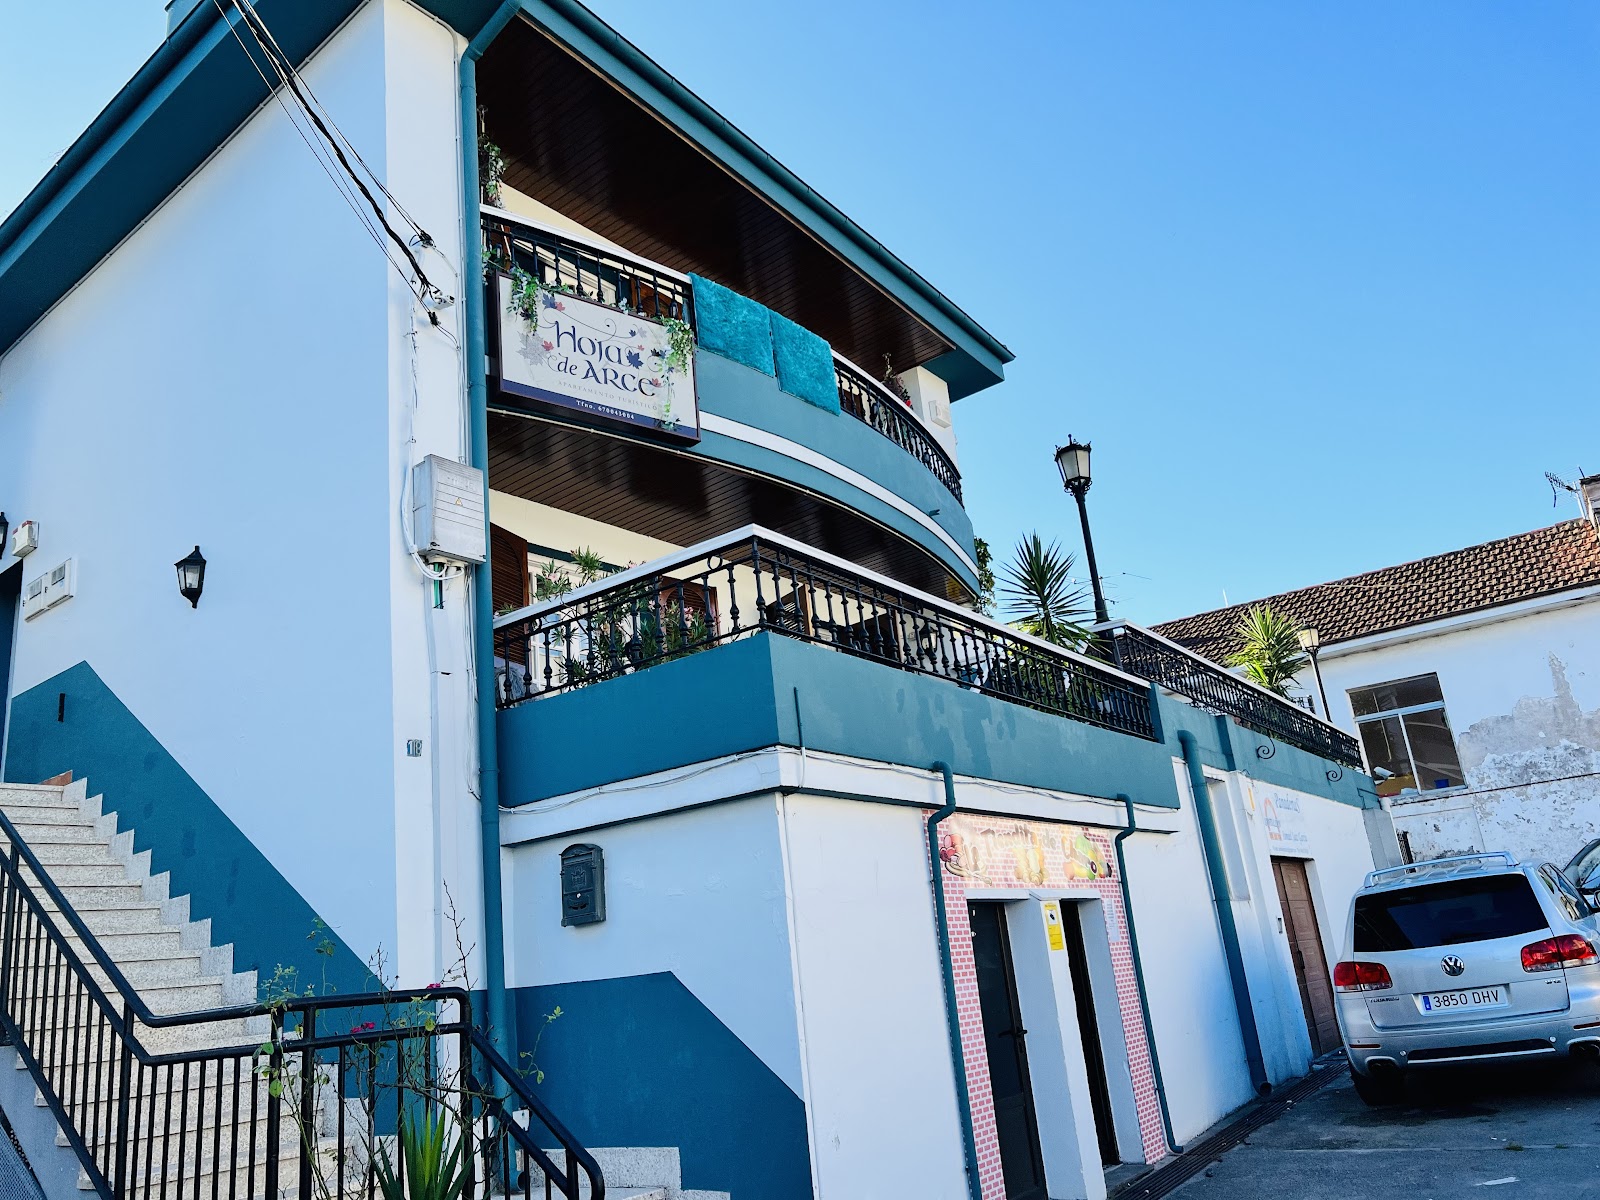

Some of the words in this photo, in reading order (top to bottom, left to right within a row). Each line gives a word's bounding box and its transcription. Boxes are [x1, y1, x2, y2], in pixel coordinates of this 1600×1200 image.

[555, 320, 632, 367] Hoja
[557, 352, 578, 376] de
[1433, 993, 1468, 1008] 3850
[1472, 989, 1498, 1004] DHV
